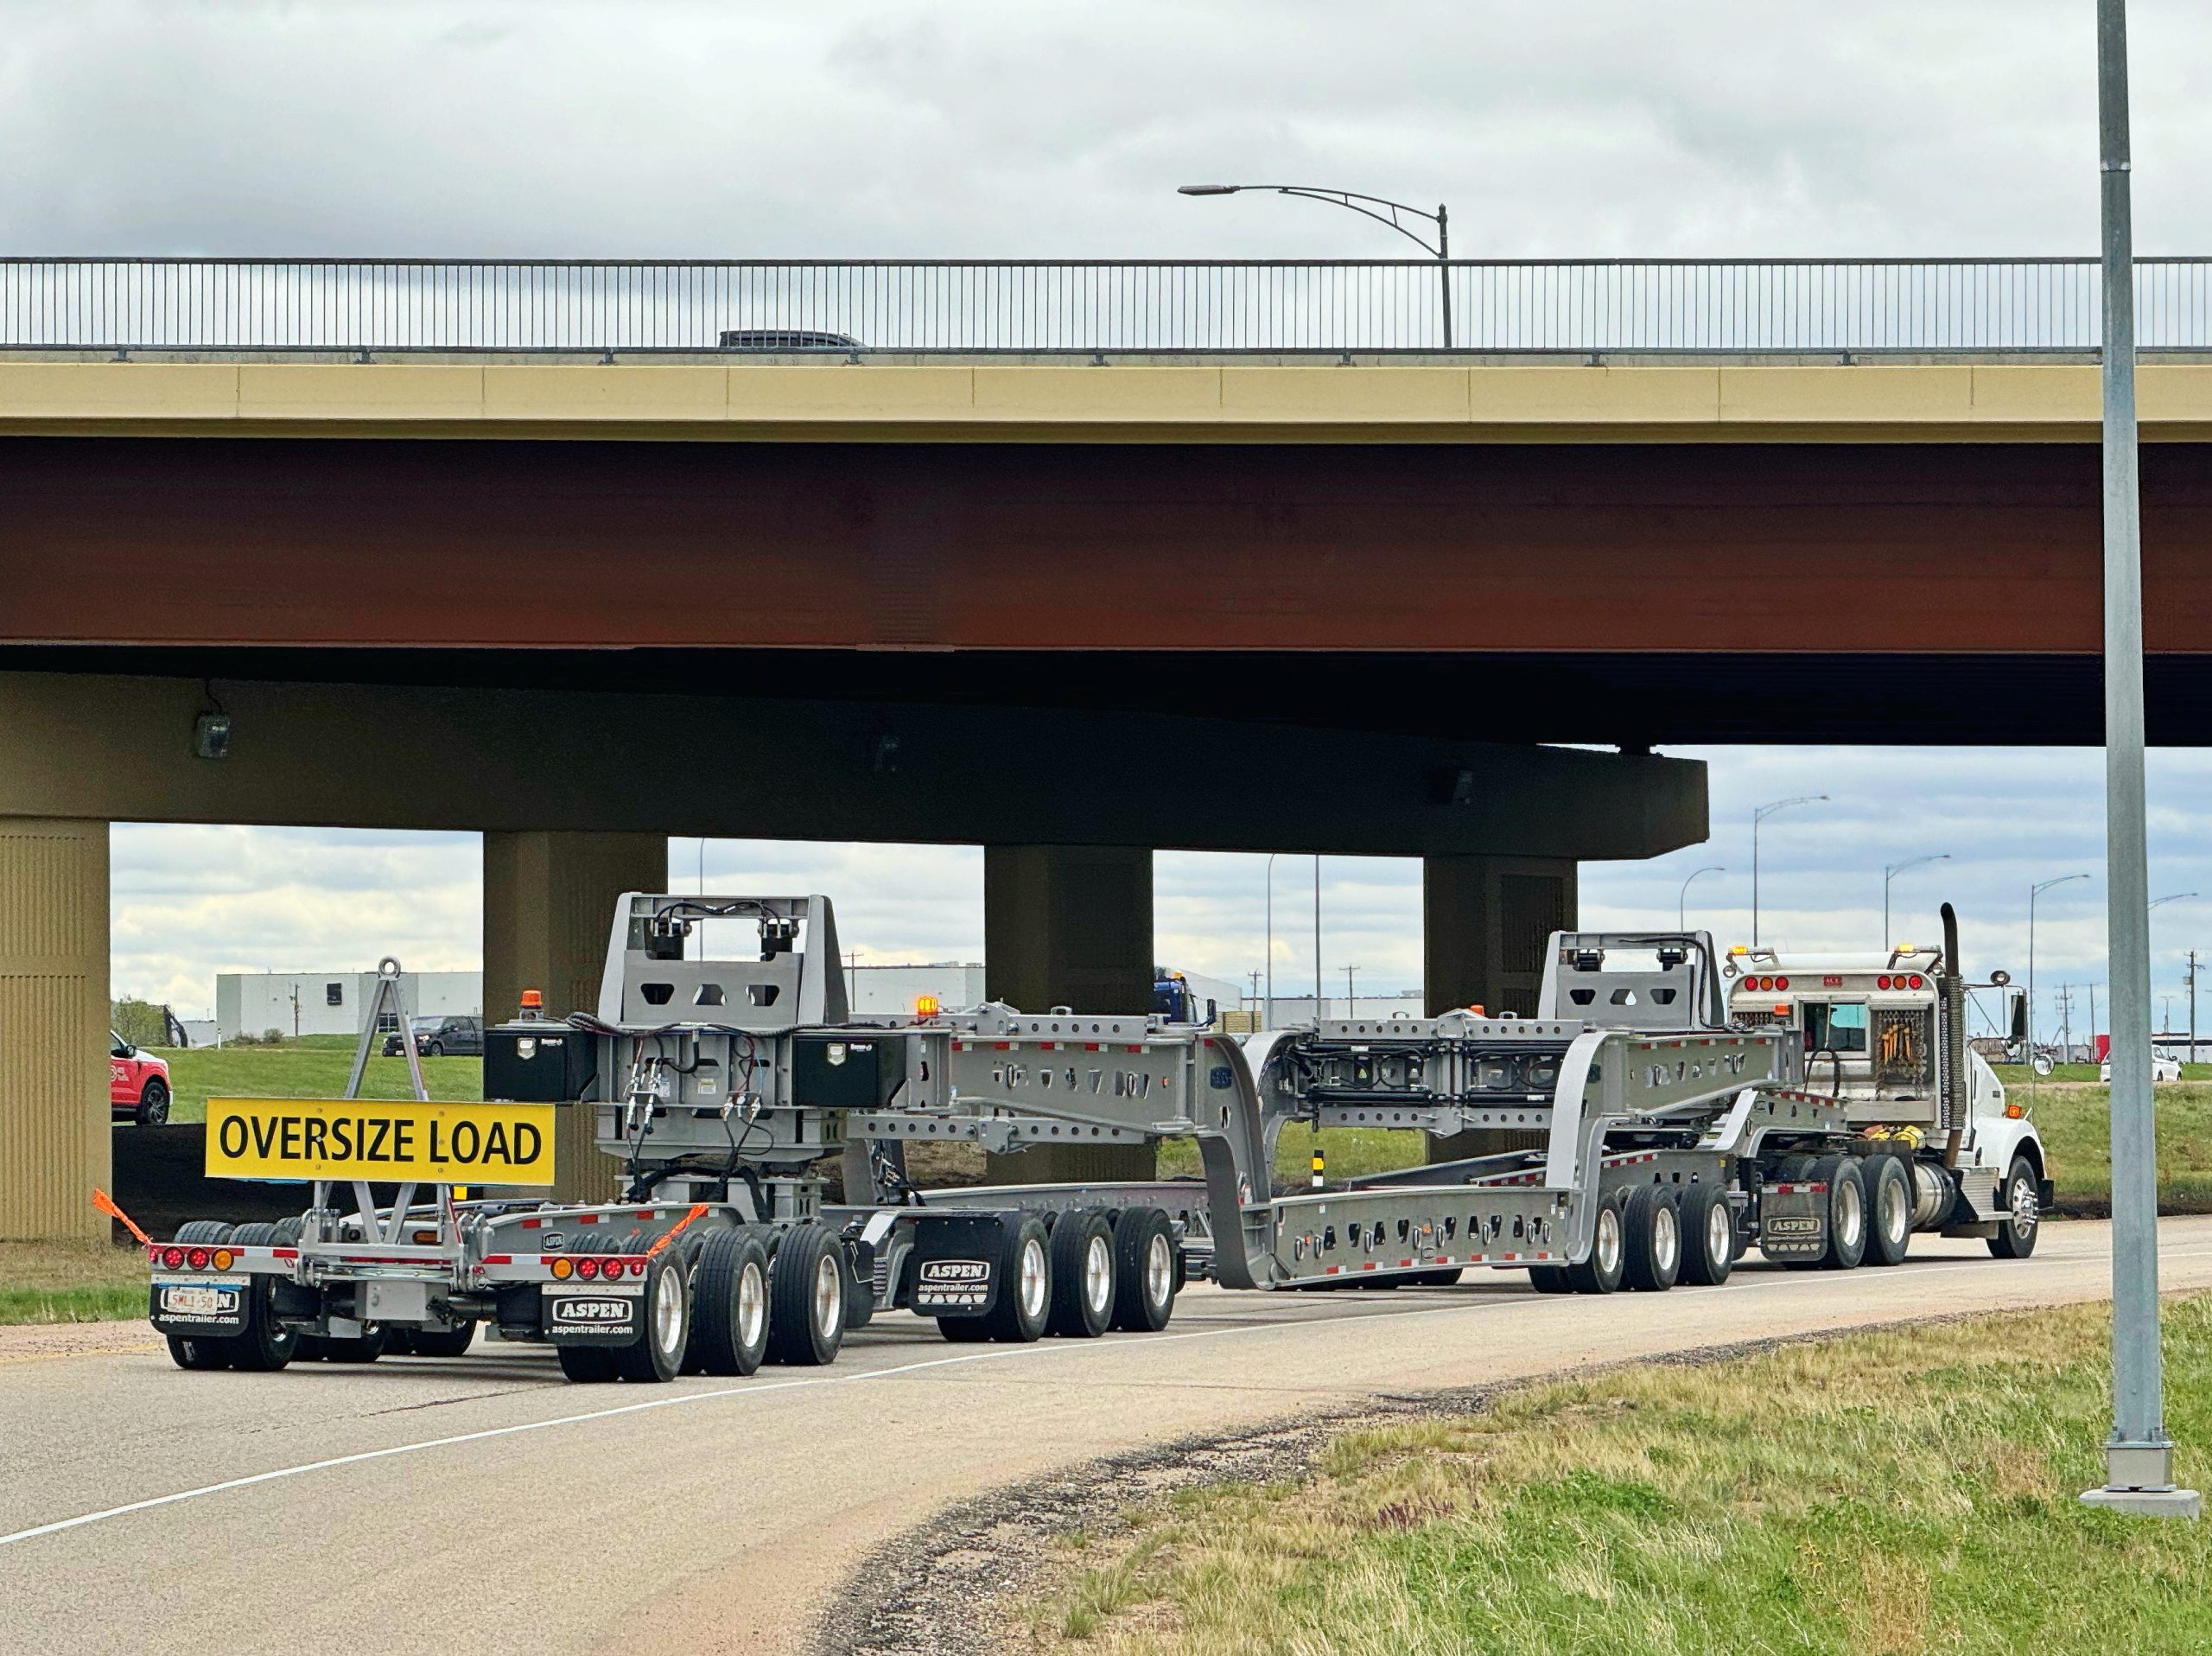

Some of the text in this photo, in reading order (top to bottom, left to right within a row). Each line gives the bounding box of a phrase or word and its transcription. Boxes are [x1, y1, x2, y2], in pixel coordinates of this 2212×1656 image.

[219, 1115, 542, 1164] OVERSIZE LOAD
[1773, 1220, 1815, 1231] ASPEN
[928, 1264, 983, 1277] ASPEN
[918, 1283, 988, 1293] aspentrailer.com
[561, 1303, 624, 1317] ASPEN
[158, 1314, 239, 1324] aspentrailer.com
[552, 1325, 632, 1334] aspentrailer.com
